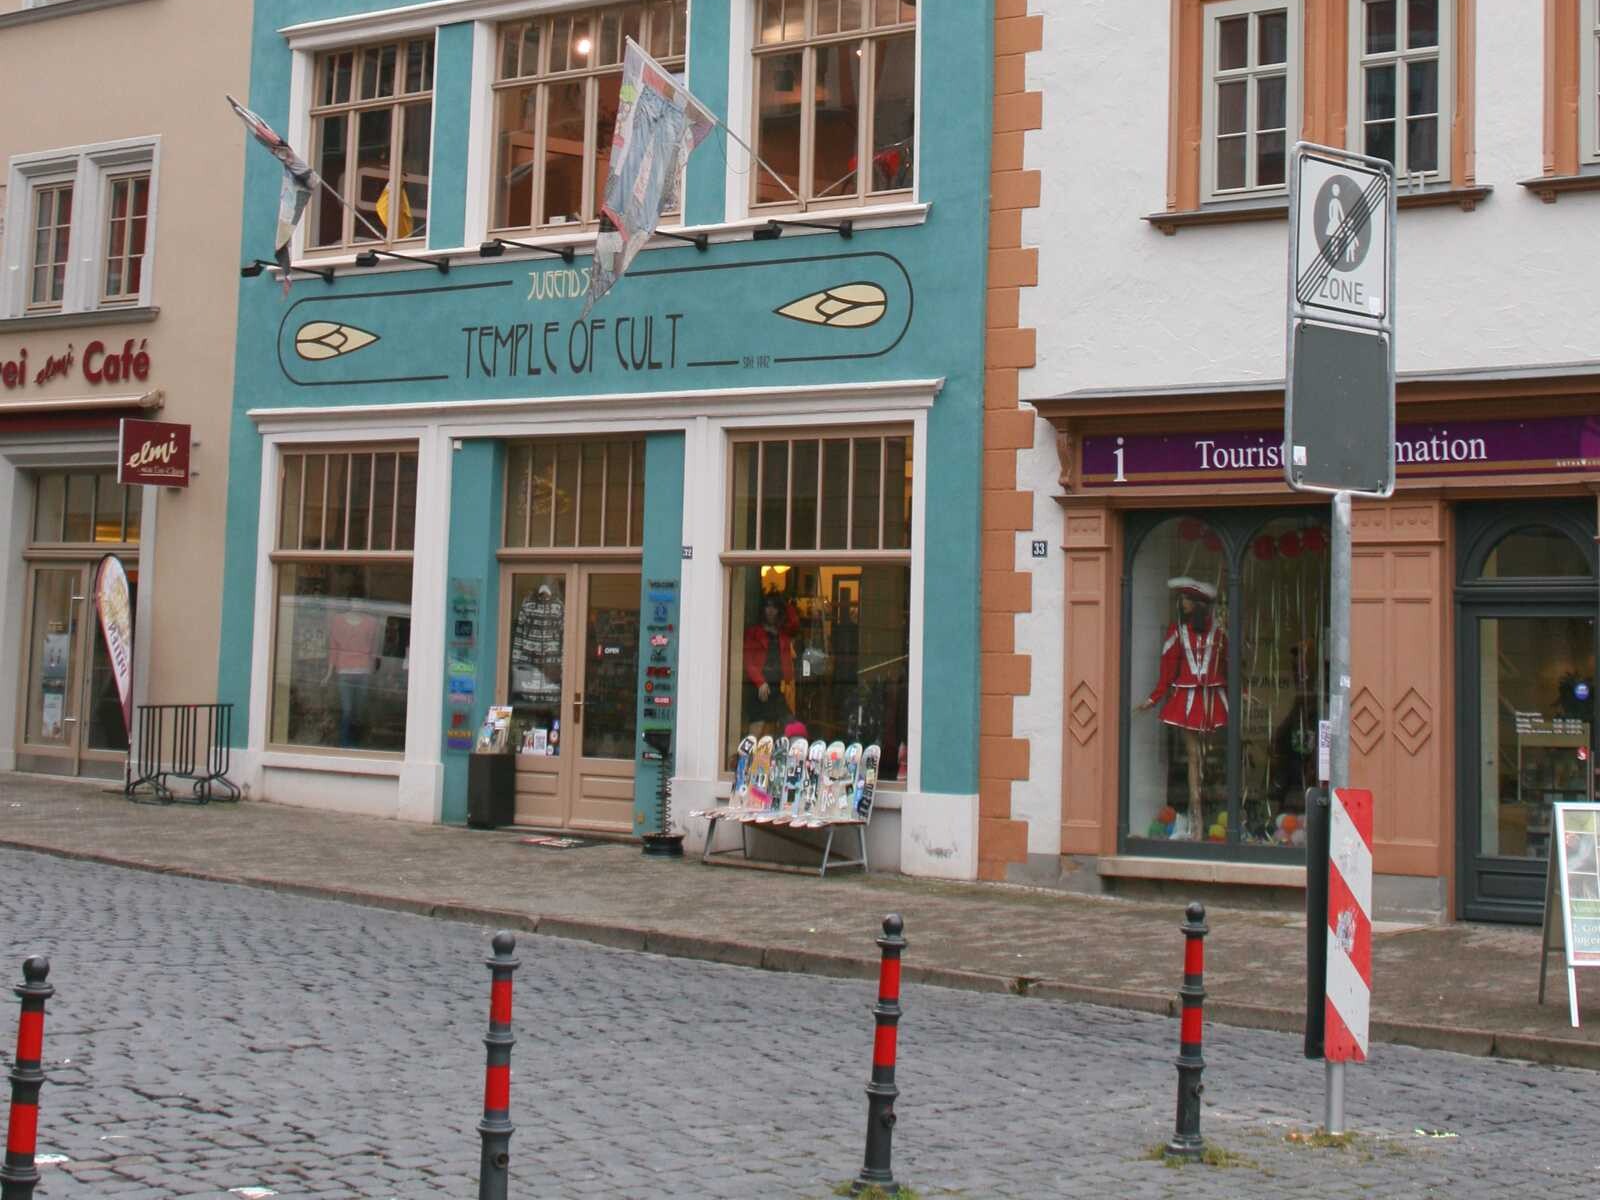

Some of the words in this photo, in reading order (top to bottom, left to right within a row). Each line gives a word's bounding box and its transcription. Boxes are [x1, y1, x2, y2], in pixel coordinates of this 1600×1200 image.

[528, 267, 610, 300] JUGENDS
[1318, 276, 1364, 306] ZONE
[462, 322, 560, 379] TEMPLE
[568, 318, 606, 374] OF
[616, 313, 684, 372] CULT
[0, 347, 28, 388] ei
[82, 338, 151, 384] Café
[126, 432, 178, 468] elmi
[1194, 437, 1286, 469] Tourist
[1034, 542, 1045, 555] 33
